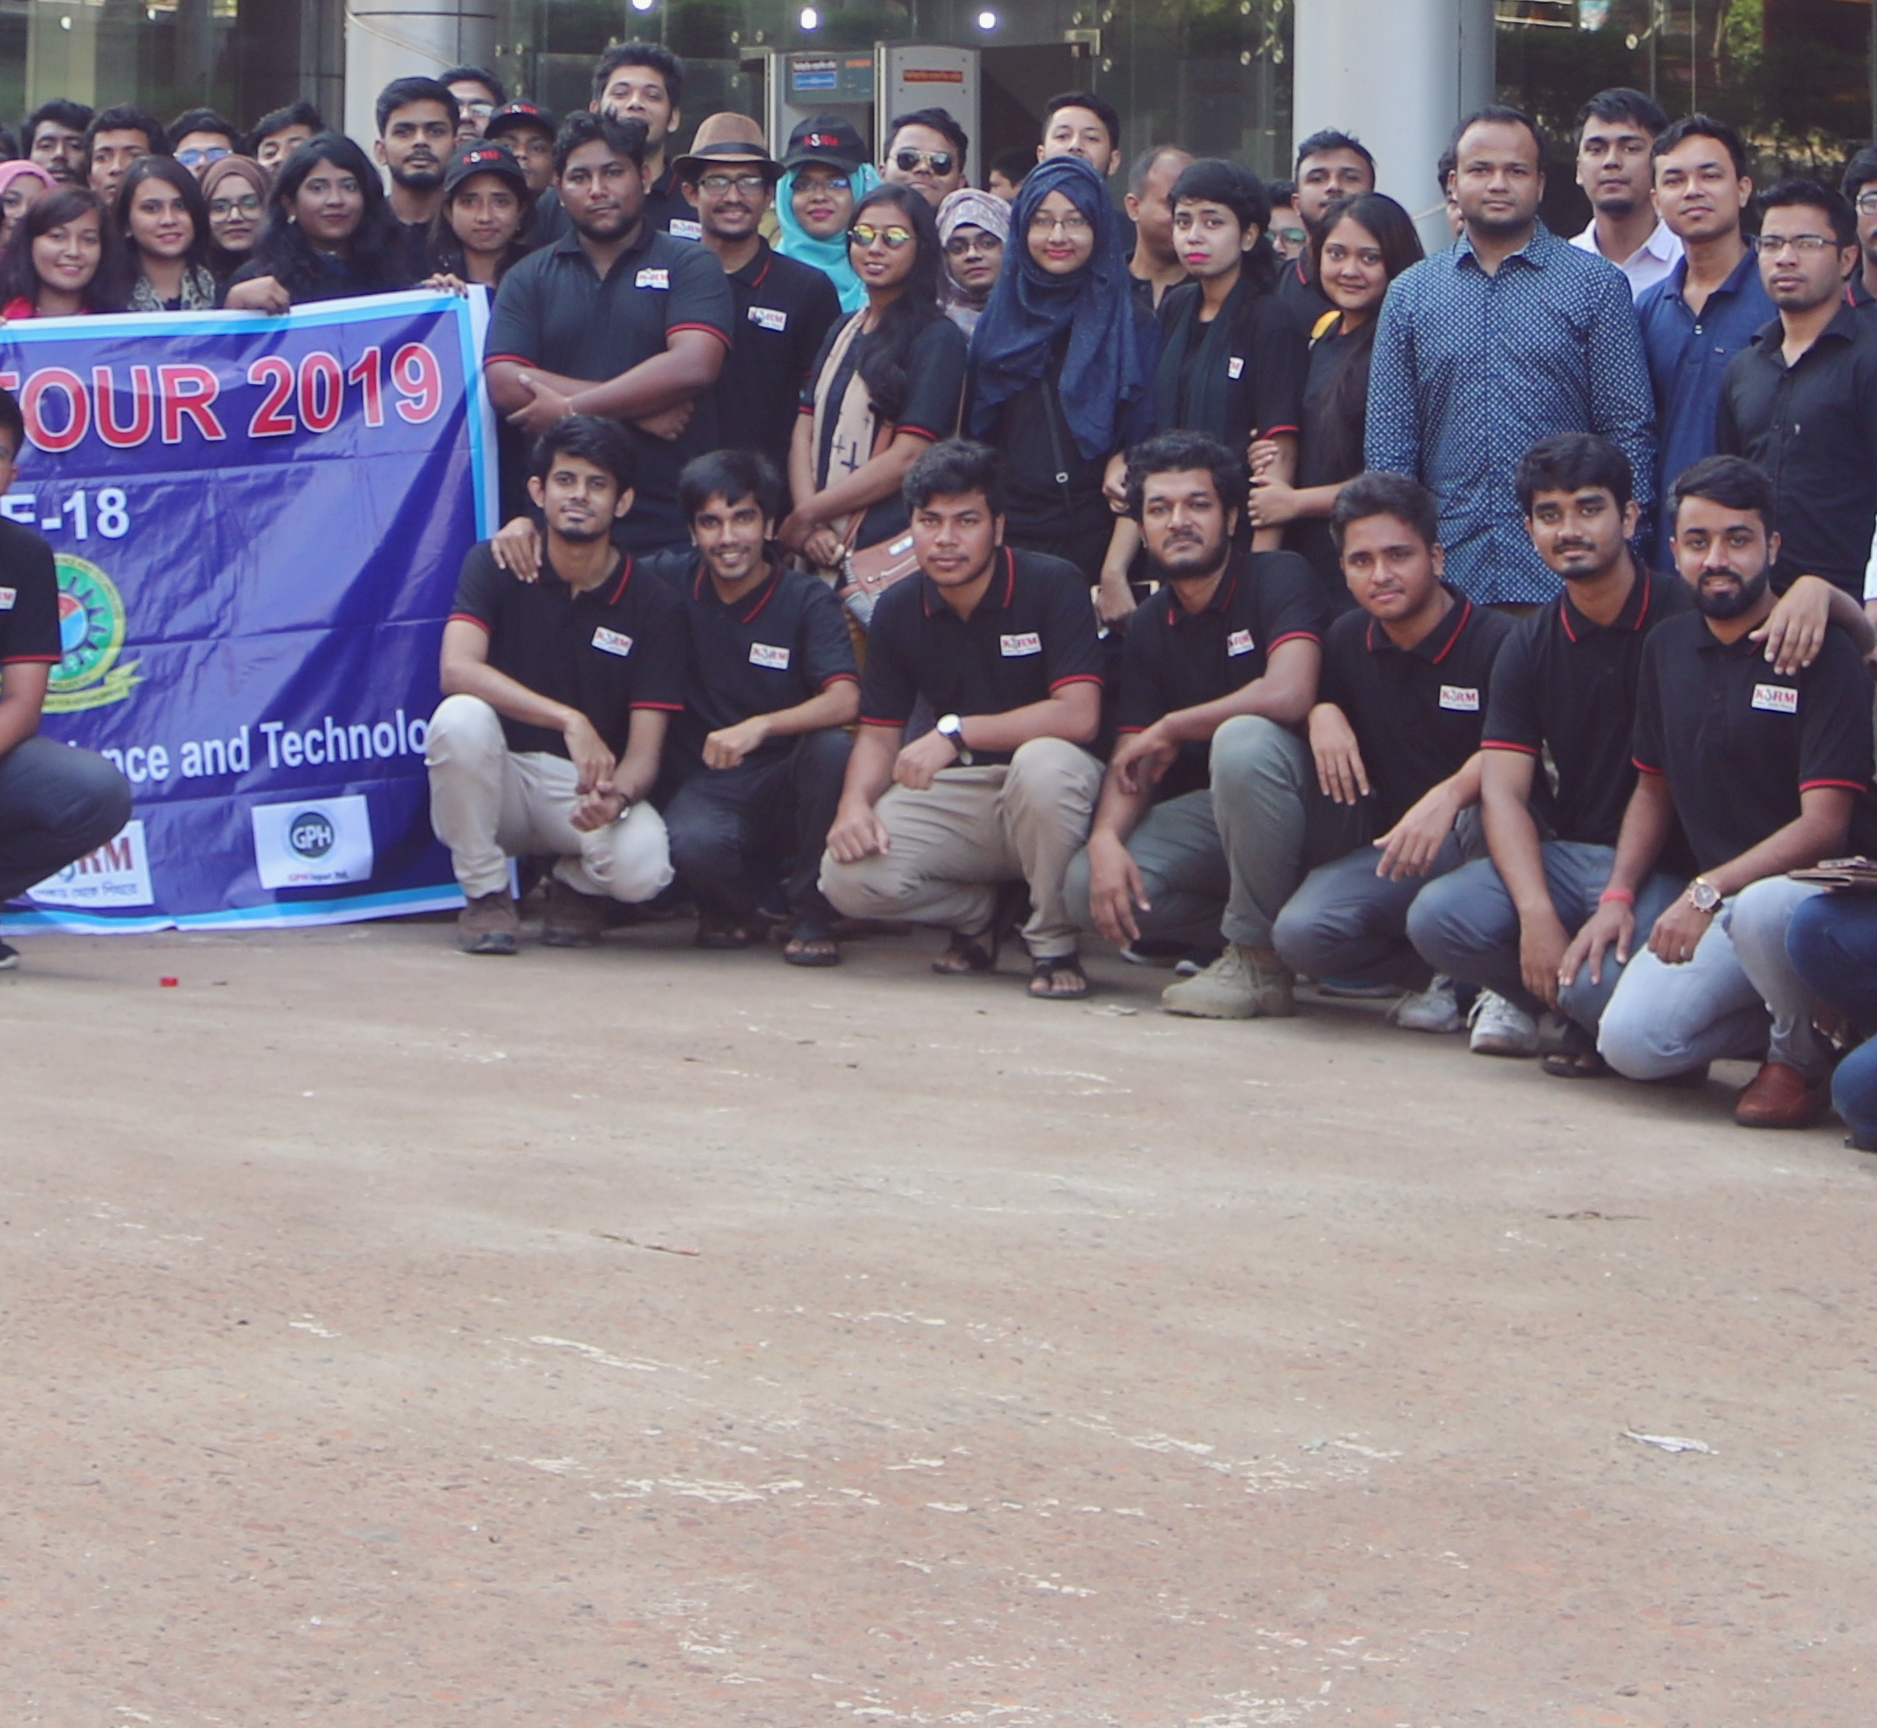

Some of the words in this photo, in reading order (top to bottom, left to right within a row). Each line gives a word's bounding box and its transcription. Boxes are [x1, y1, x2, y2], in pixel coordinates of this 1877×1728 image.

[246, 341, 441, 439] 2019
[180, 725, 252, 778] and
[260, 708, 430, 769] Technolo
[292, 825, 333, 849] GPH
